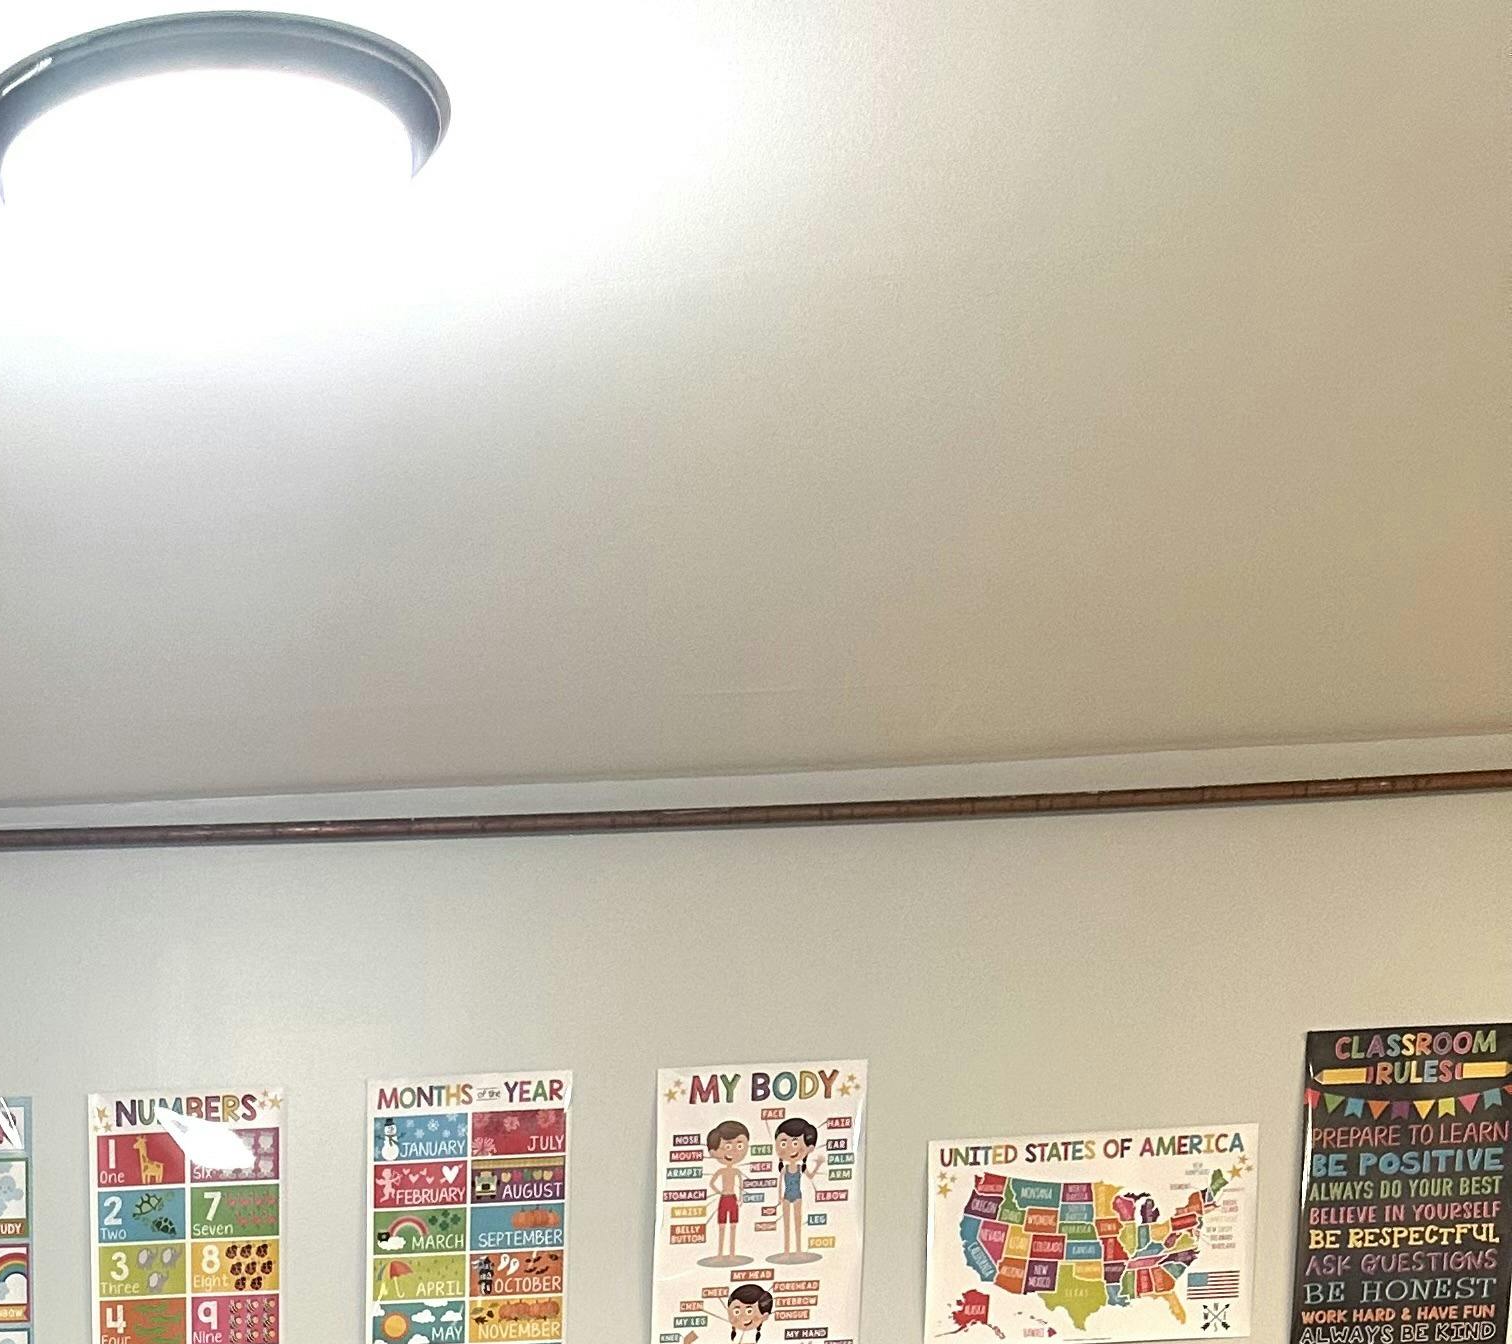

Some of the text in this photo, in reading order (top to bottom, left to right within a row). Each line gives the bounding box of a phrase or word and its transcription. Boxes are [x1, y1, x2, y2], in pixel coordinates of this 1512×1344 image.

[1335, 1030, 1497, 1060] CLASSROOM
[1376, 1059, 1453, 1085] RULES
[377, 1079, 564, 1110] MONTHS YEAR
[689, 1068, 839, 1105] MY BODY
[527, 1135, 565, 1151] JULY
[1313, 1121, 1509, 1148] PREPARE TO LEARN
[399, 1140, 466, 1158] JANUARY
[940, 1133, 1244, 1167] UNITED STATES OF AMERICA
[1312, 1147, 1504, 1178] BE POSITIVE
[396, 1187, 466, 1204] FEBRUARY
[502, 1182, 564, 1199] AUGUST
[663, 1192, 705, 1200] STOMACH
[816, 1192, 847, 1200] ELBOW
[1310, 1175, 1502, 1201] ALWAYS DO YOUR BEST
[104, 1197, 123, 1224] 2
[204, 1192, 223, 1221] 7
[1310, 1201, 1501, 1225] BELIEVE IN YOURSELF
[193, 1223, 234, 1236] Seven
[478, 1229, 563, 1247] SEPTEMBER
[1309, 1224, 1500, 1249] BE RESPECTFUL
[1306, 1249, 1497, 1276] ASK QUESTIONS
[416, 1280, 464, 1296] APRIL
[494, 1277, 562, 1293] OCTOBER
[1304, 1278, 1496, 1305] BE HONEST
[1302, 1304, 1495, 1324] WORK HARD & HAVE FUN
[432, 1326, 464, 1341] MAY
[478, 1321, 561, 1338] NOVEMBER
[1299, 1321, 1496, 1344] ALWAYS BE KIND
